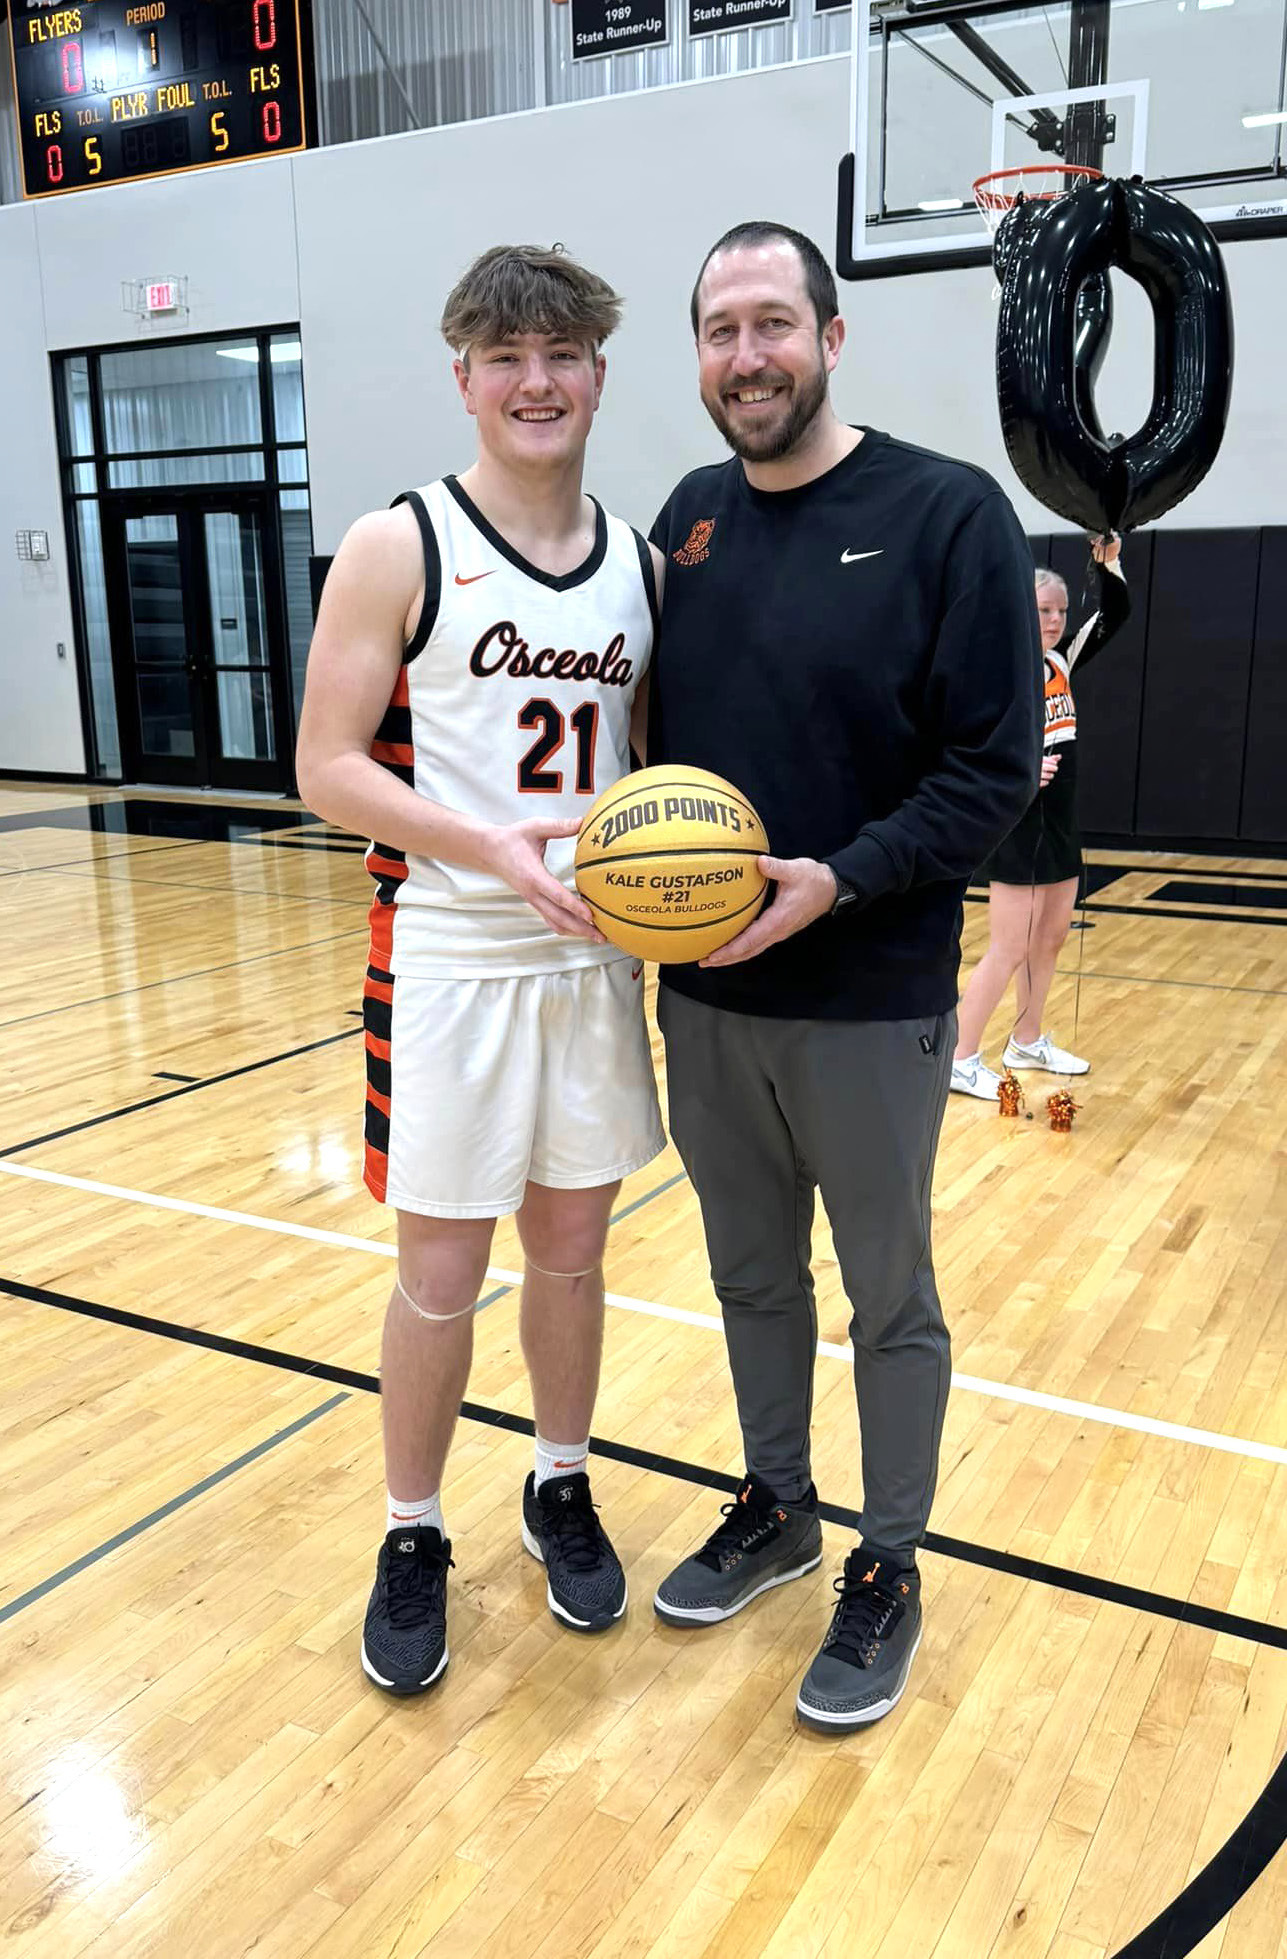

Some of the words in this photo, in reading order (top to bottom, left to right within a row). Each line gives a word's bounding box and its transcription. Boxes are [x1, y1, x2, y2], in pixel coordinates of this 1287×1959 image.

[126, 2, 166, 26] PERIOD
[605, 6, 632, 22] 1989
[693, 8, 723, 22] State
[725, 0, 786, 15] Runner-Up
[29, 8, 83, 44] FLYERS
[576, 32, 604, 46] State
[606, 18, 662, 39] Runner-Up
[61, 41, 84, 94] 0
[250, 64, 281, 93] FLS
[111, 92, 149, 123] PLYR
[157, 83, 195, 112] FOUL
[202, 80, 233, 101] T.O.L.
[34, 111, 62, 137] FLS
[77, 107, 104, 127] T.O.L.
[263, 101, 282, 142] 0
[210, 111, 230, 152] 5
[47, 144, 64, 183] 0
[84, 137, 102, 175] 5
[150, 285, 170, 307] EXIT
[469, 620, 634, 688] Osceola
[517, 696, 599, 795] 21
[600, 801, 658, 848] 2000
[664, 797, 741, 833] POINTS
[605, 871, 645, 888] KALE
[650, 866, 743, 888] GUSTAFSON
[625, 903, 672, 914] OSCEOLA
[674, 900, 727, 913] BULLDOGS
[662, 890, 690, 903] #21
